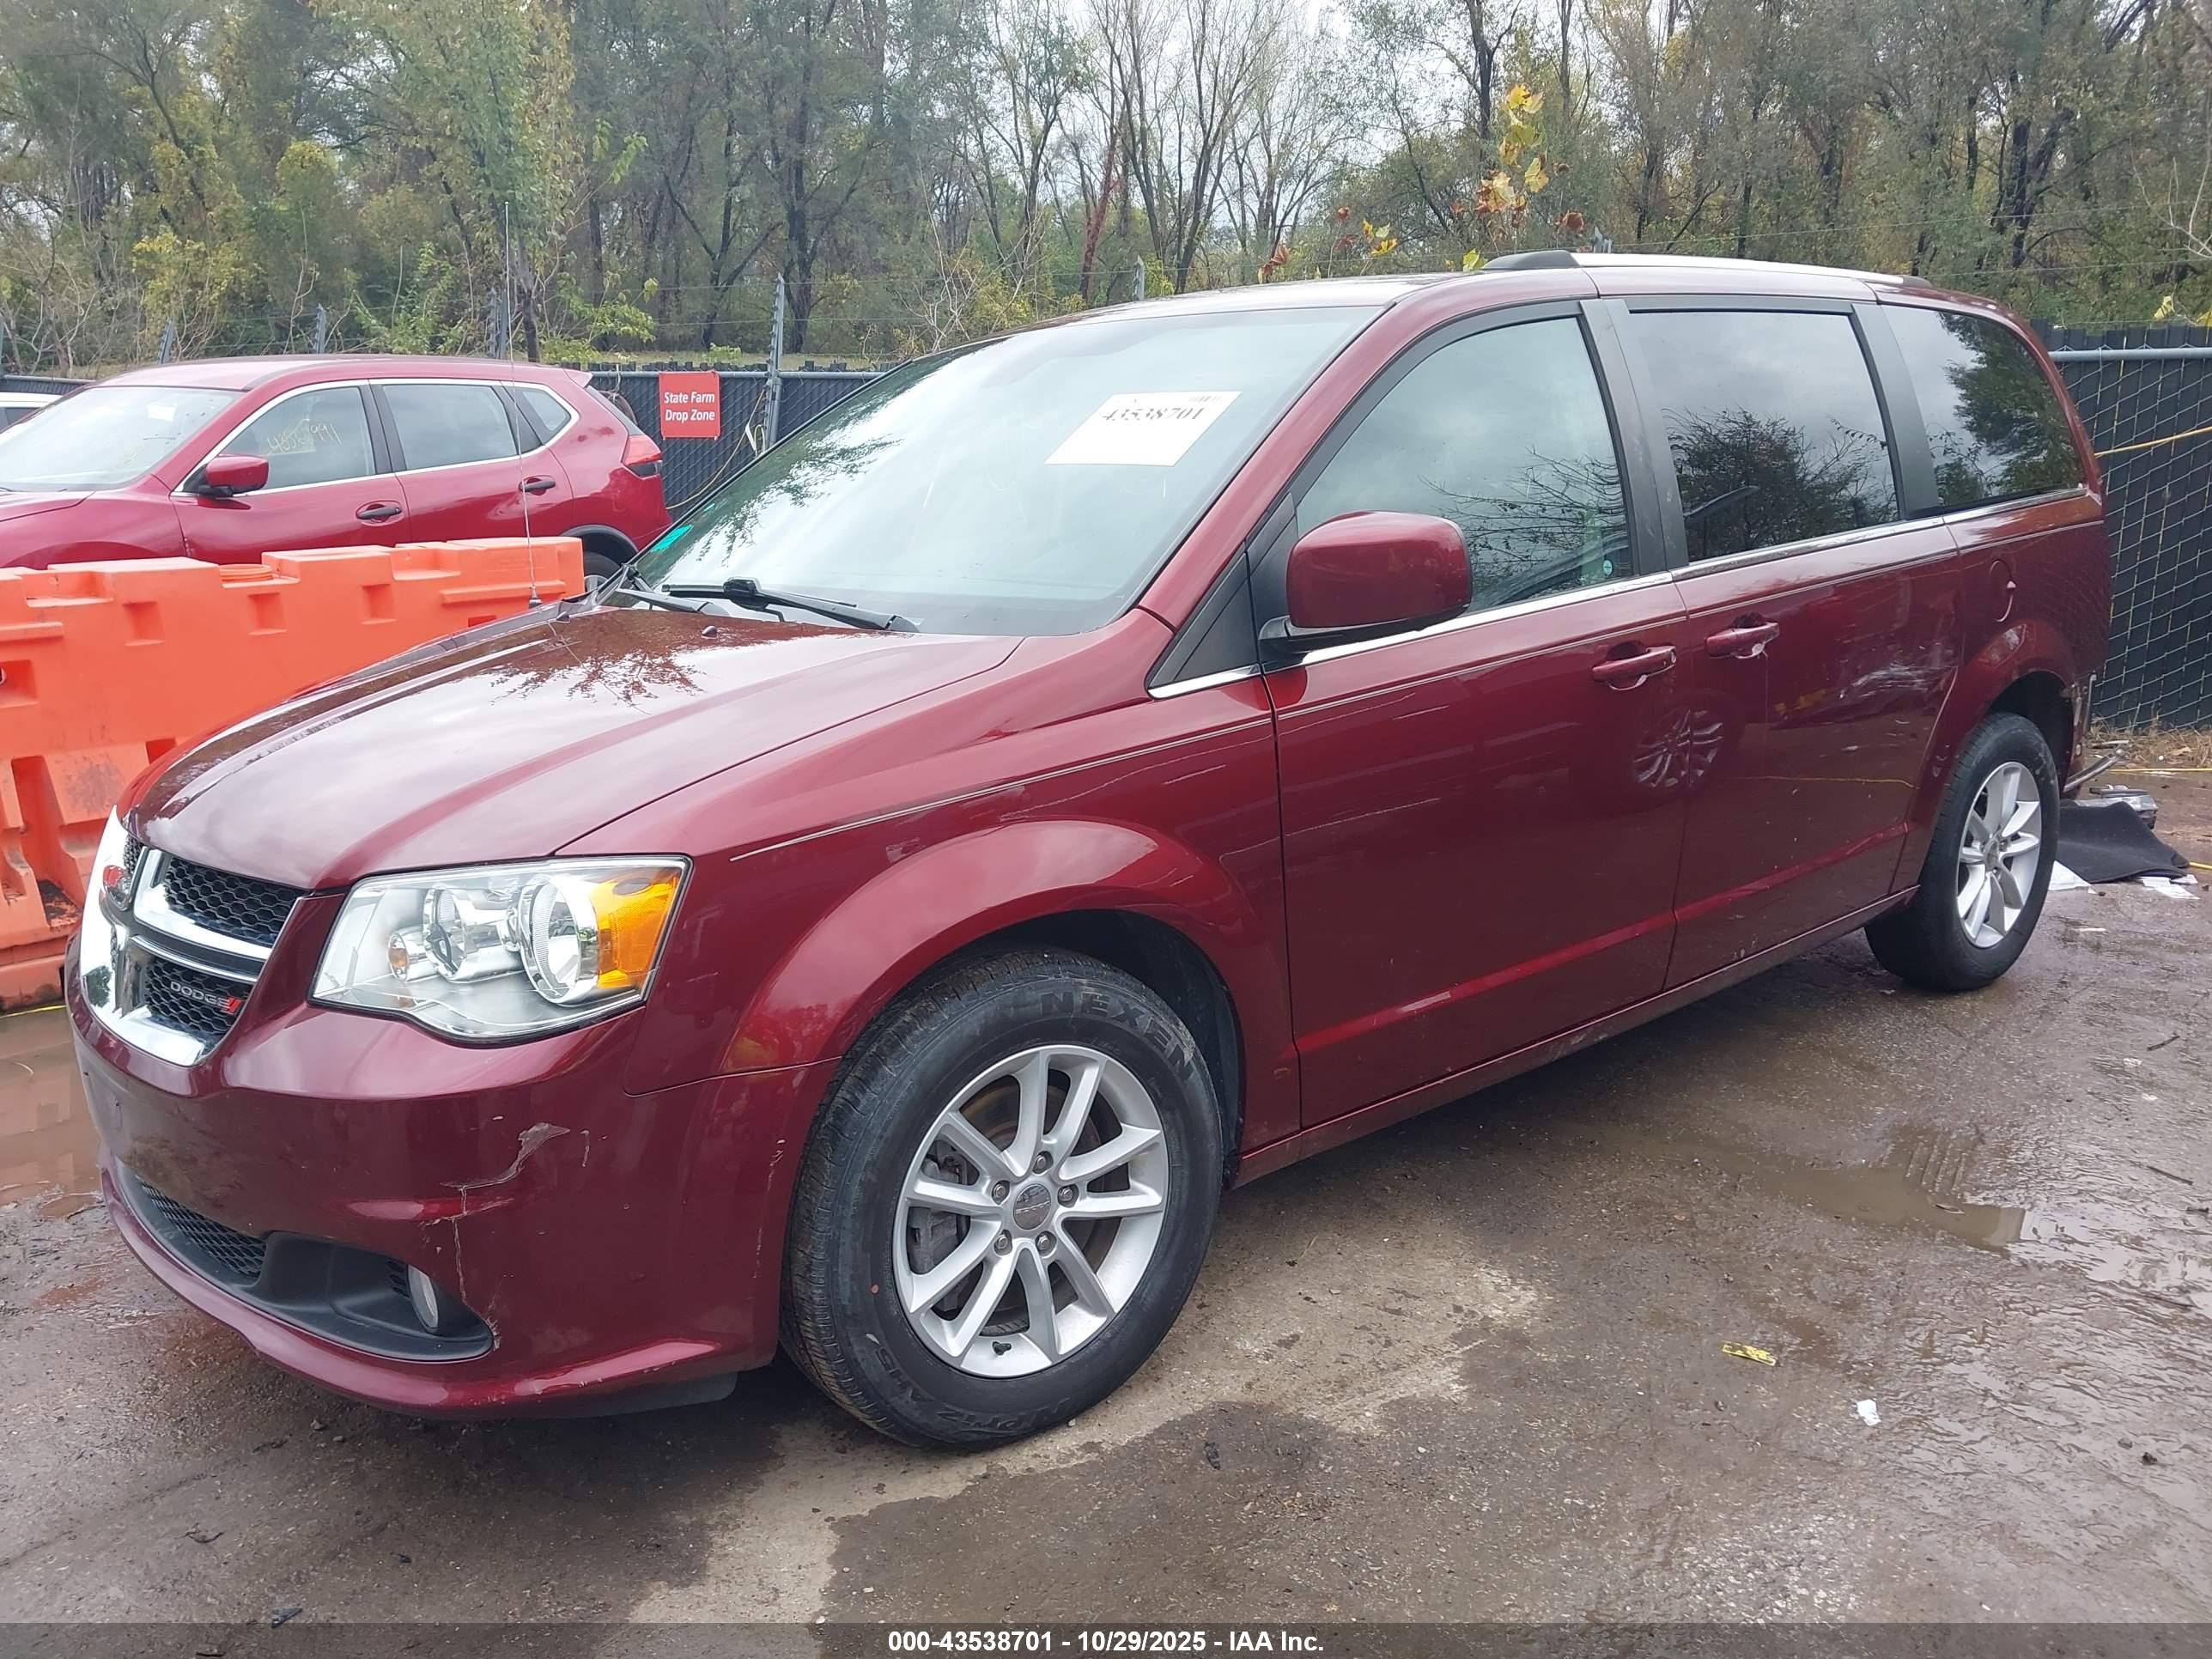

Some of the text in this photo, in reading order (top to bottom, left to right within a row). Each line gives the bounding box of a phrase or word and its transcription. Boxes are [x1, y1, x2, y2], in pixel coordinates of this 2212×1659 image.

[664, 392, 714, 404] State Farm
[665, 409, 714, 423] Drop Zone
[170, 981, 230, 1013] DODGE
[1040, 991, 1195, 1081] NEXEN
